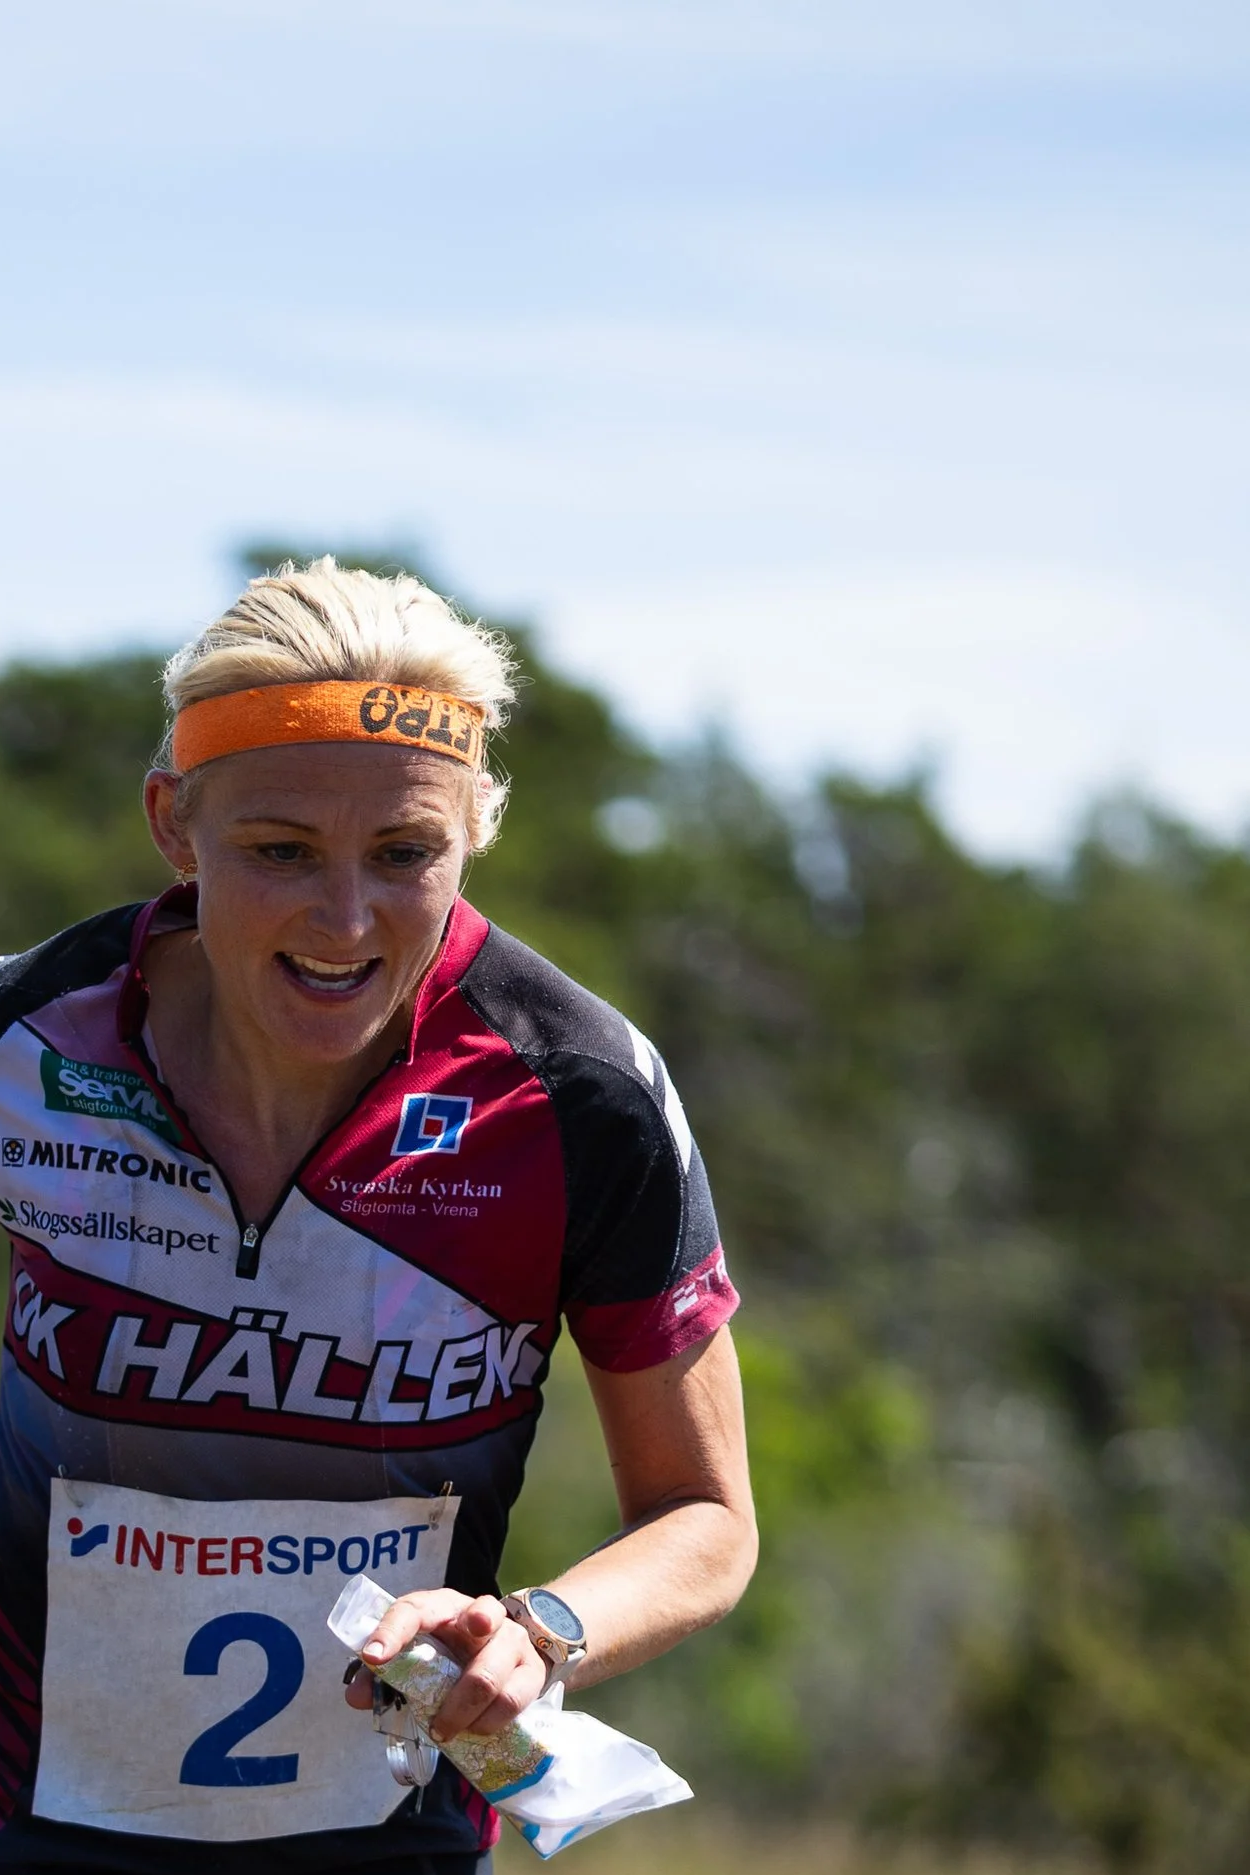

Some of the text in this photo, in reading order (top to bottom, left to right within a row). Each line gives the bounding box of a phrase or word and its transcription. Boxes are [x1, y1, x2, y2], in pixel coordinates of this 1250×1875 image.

[79, 1066, 89, 1076] &
[28, 1140, 211, 1193] MILTRONIC
[325, 1175, 502, 1200] Svenska Kyrkan
[19, 1200, 220, 1254] Skogssällskapet
[340, 1199, 417, 1216] Stigtomta
[432, 1202, 479, 1217] Vrena
[96, 1312, 539, 1422] HÄLLEN
[115, 1523, 430, 1576] INTERSPORT
[178, 1611, 305, 1787] 2
